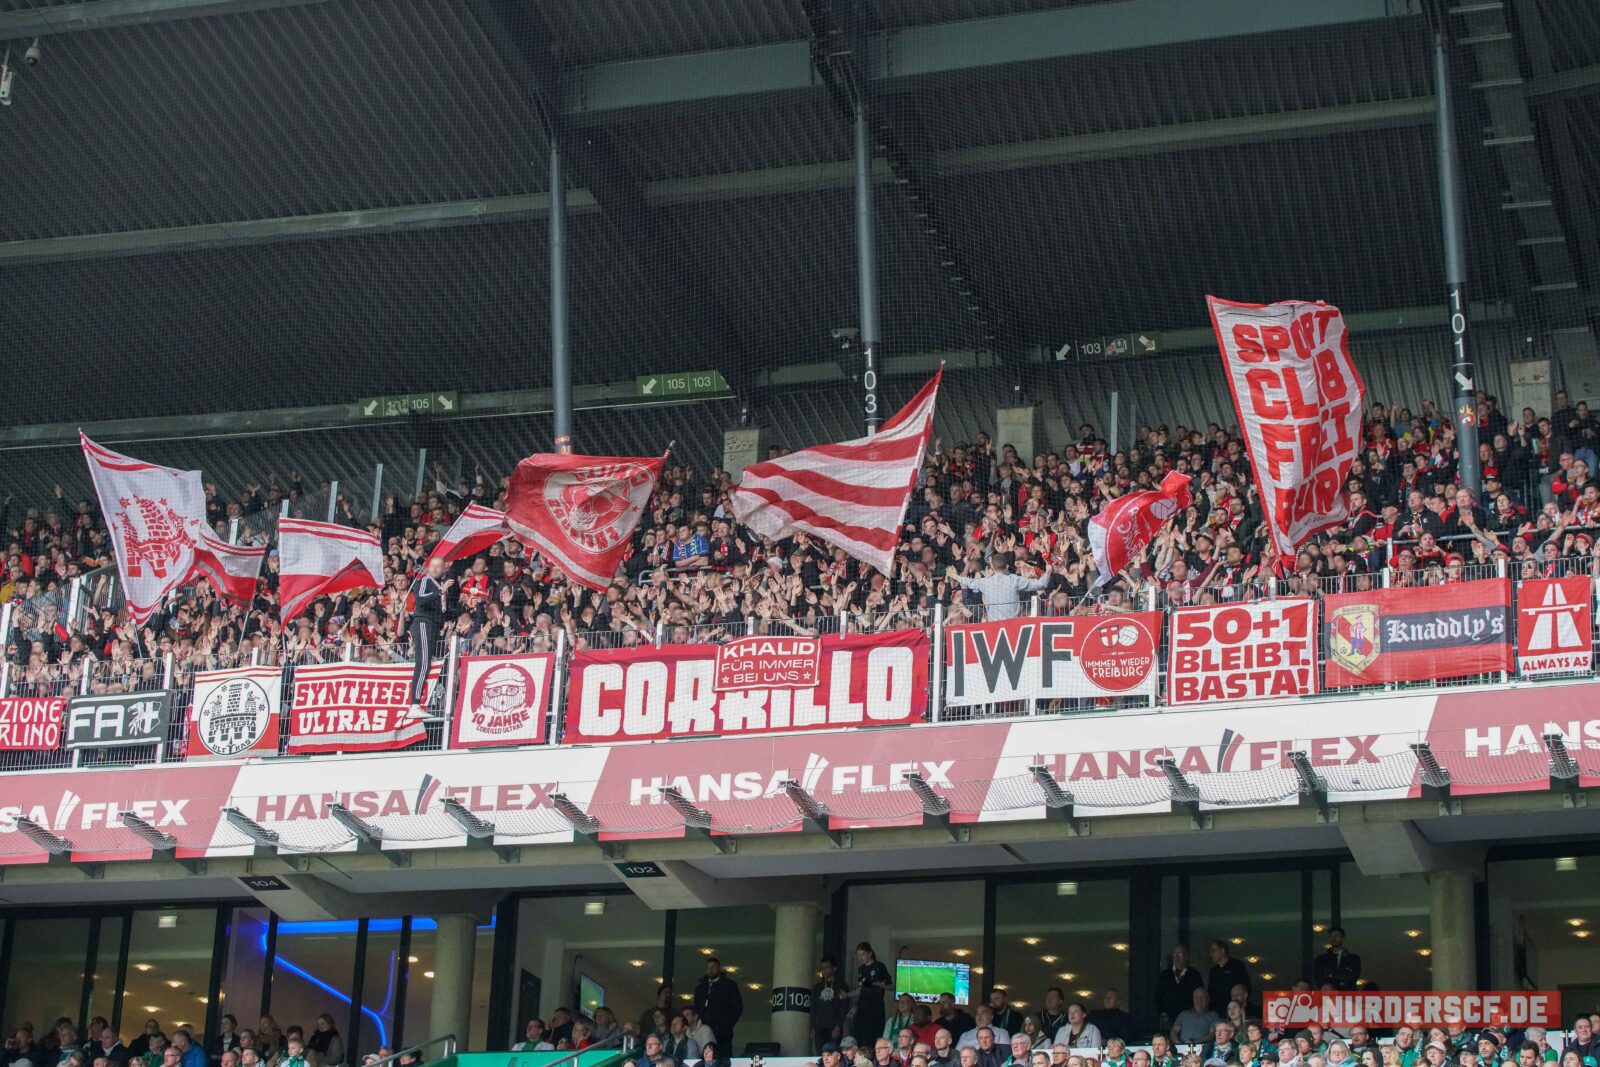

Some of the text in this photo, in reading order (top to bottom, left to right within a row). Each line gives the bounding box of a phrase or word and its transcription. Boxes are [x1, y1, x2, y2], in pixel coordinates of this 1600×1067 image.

[1451, 289, 1465, 358] 101
[1232, 310, 1339, 363] SPORT
[1081, 343, 1101, 354] 103
[667, 377, 711, 389] 105 103
[864, 348, 877, 413] 103
[412, 399, 429, 409] 105
[1177, 602, 1309, 648] 50+1
[1386, 610, 1505, 643] Knaddly's
[723, 642, 815, 659] KHALID
[952, 622, 1075, 697] IWF
[1175, 640, 1311, 674] BLEIBT.
[721, 659, 814, 673] FÜR IMMER
[1092, 665, 1144, 678] FREIBURG
[1119, 656, 1150, 667] WIEDER
[1522, 656, 1589, 671] ALWAYS A5
[733, 671, 799, 684] BEI UNS
[1175, 668, 1309, 702] BASTA!
[0, 700, 62, 723] ZIONE
[299, 709, 389, 735] ULTRAS
[471, 709, 530, 728] 10 JAHRE
[68, 704, 125, 741] FA
[210, 720, 256, 731] SYNTHESIA
[0, 723, 58, 746] RLINO
[832, 760, 956, 795] FLEX
[626, 866, 656, 874] 102
[789, 992, 810, 1007] 102
